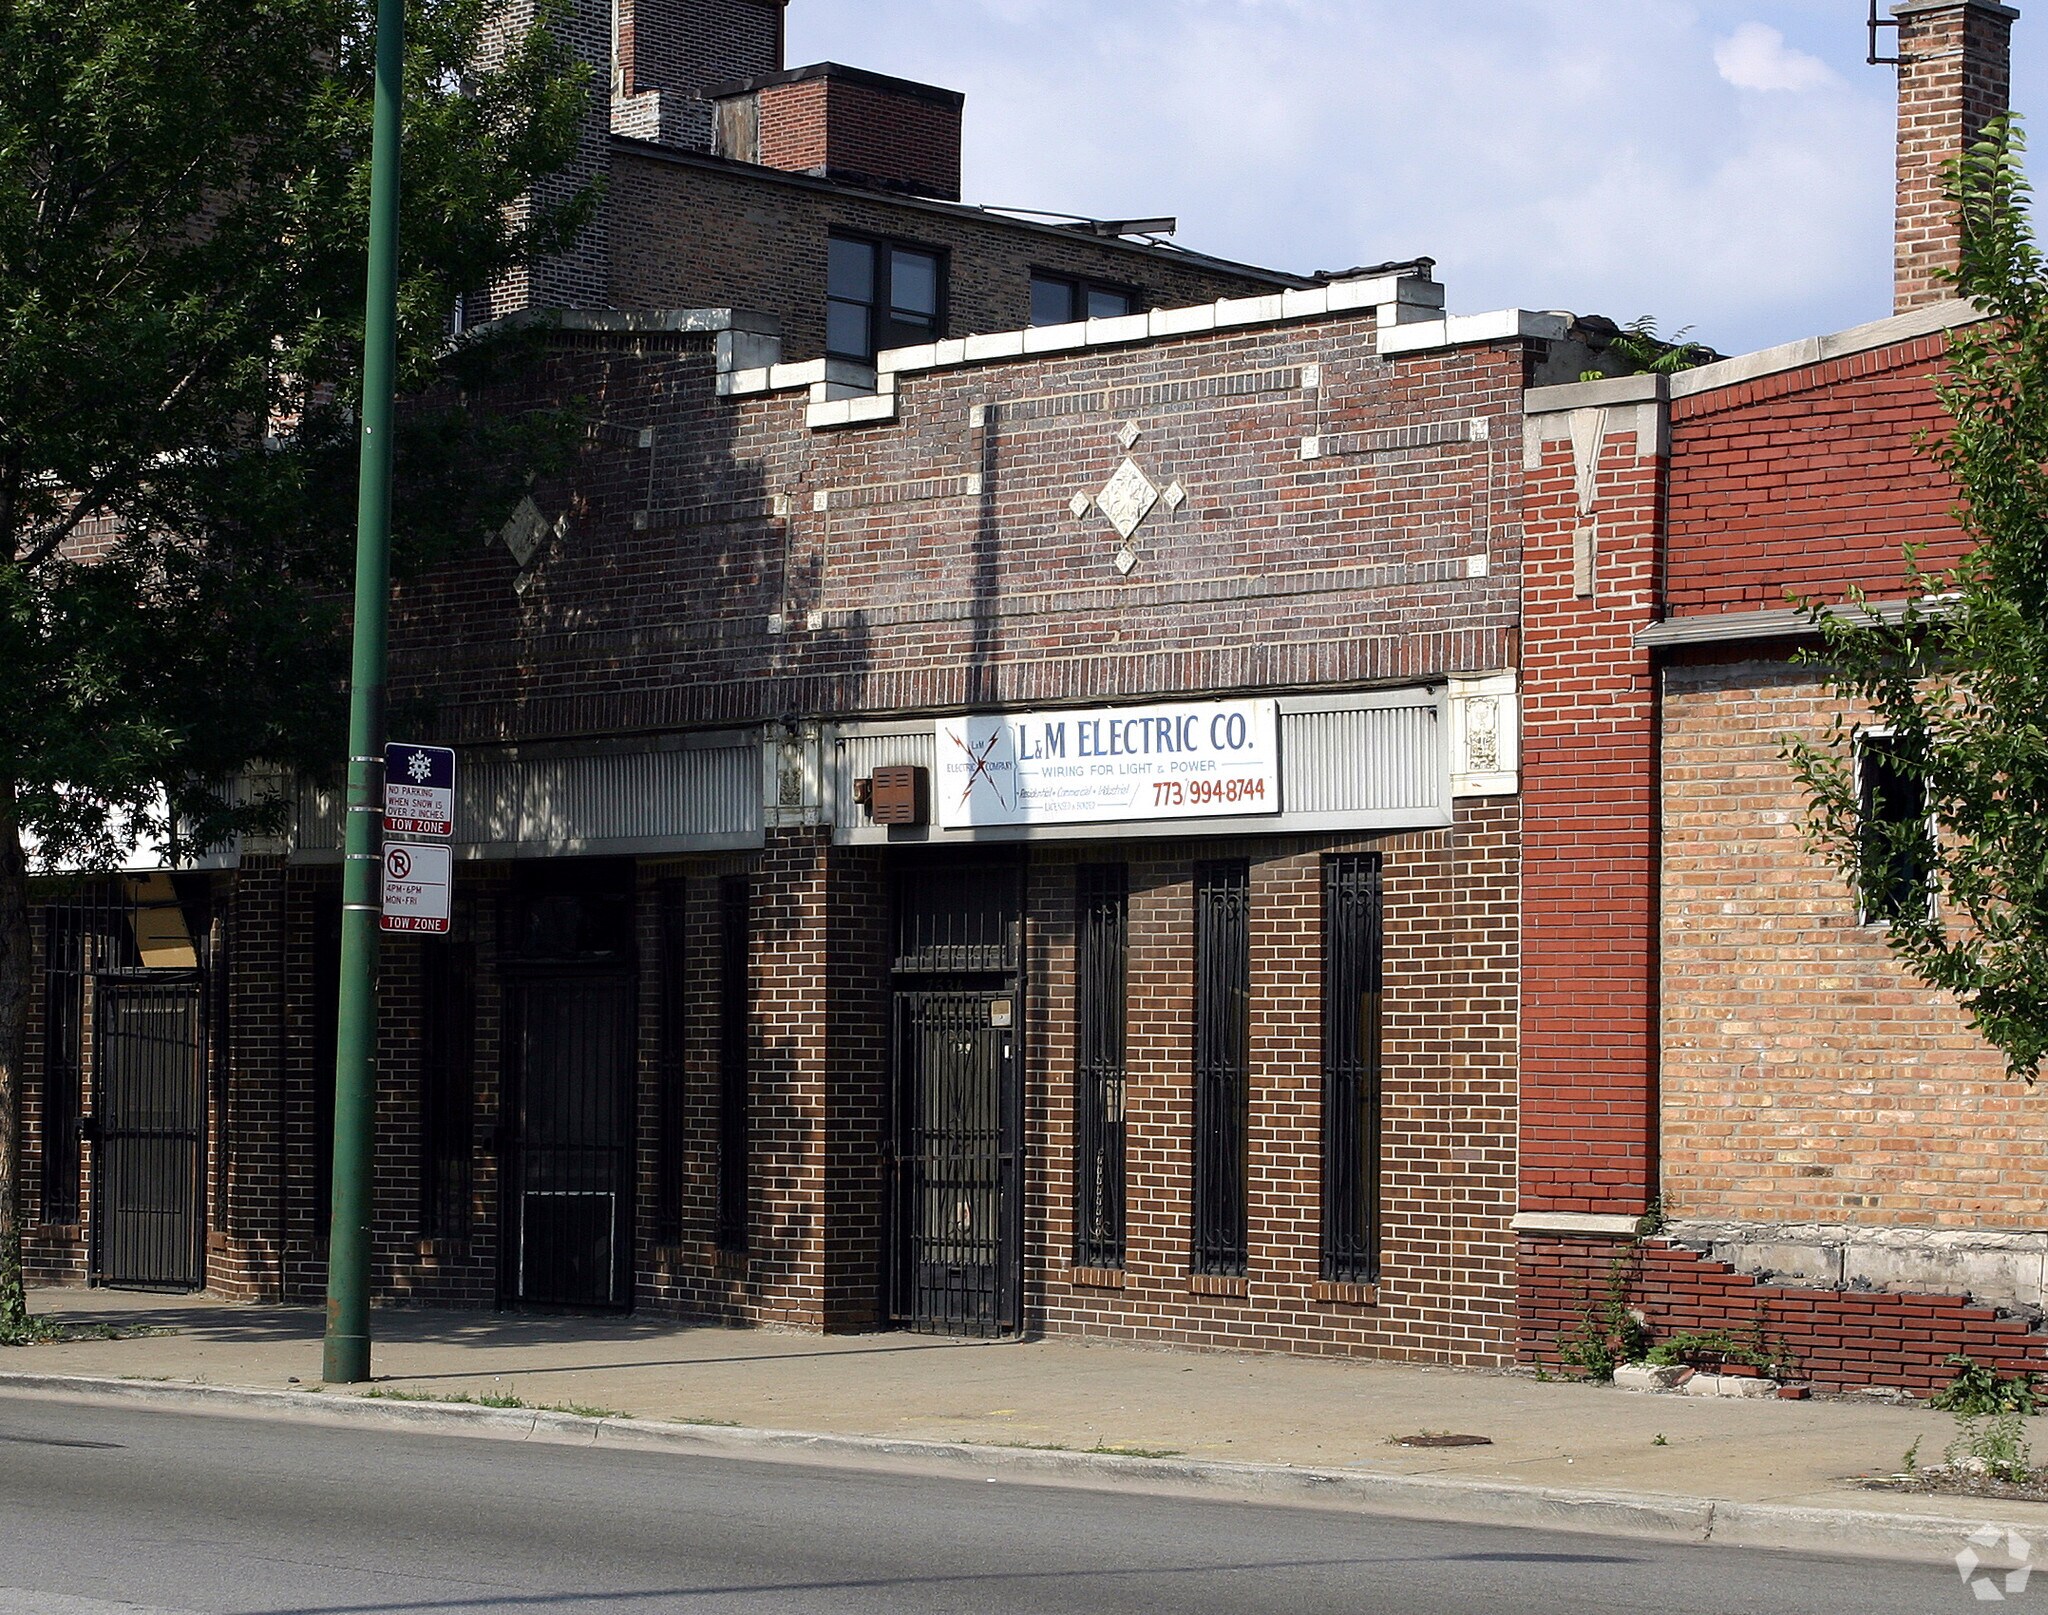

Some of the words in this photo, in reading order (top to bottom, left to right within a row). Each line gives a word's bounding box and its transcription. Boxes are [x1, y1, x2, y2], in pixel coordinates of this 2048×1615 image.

[1019, 722, 1066, 760] L&M
[1077, 715, 1199, 757] ELECTRIC
[1210, 713, 1254, 750] CO.
[985, 761, 1012, 771] COMPANY
[1042, 763, 1084, 777] WIRING
[1090, 764, 1114, 775] FOR
[1119, 763, 1152, 774] LIGHT
[1170, 760, 1217, 772] POWER
[388, 786, 399, 794] NO
[402, 787, 433, 797] PARKING
[388, 797, 409, 806] WHEN
[412, 799, 432, 808] SNOW
[435, 801, 442, 809] IS
[388, 807, 407, 816] OVER
[410, 809, 416, 817] 2
[418, 810, 445, 819] INCHES
[391, 818, 413, 831] TOW
[417, 820, 444, 833] ZONE
[388, 916, 410, 928] TOW
[414, 918, 441, 930] ZONE
